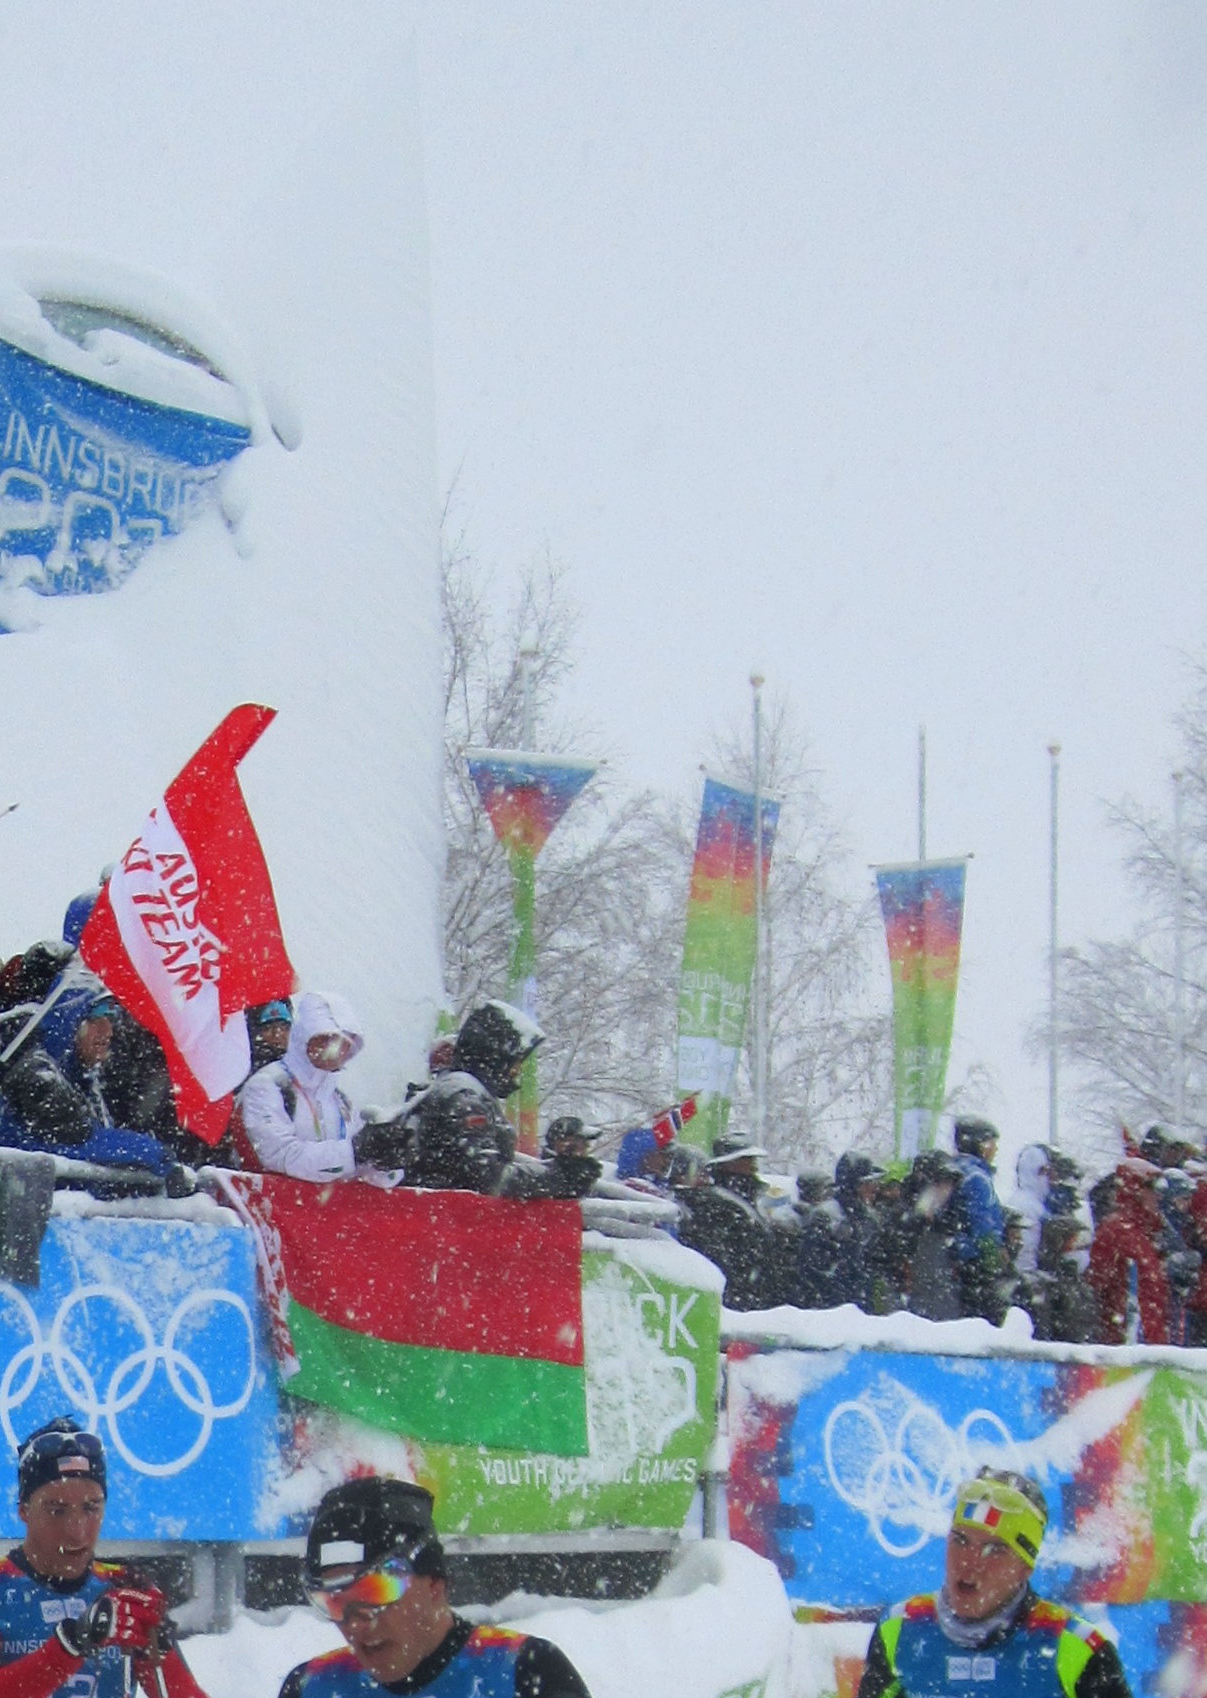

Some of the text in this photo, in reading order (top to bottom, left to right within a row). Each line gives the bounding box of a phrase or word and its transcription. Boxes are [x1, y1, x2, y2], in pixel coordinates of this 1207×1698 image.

[2, 411, 194, 530] INNSBRU
[132, 888, 203, 1001] TEAM
[479, 1458, 547, 1489] YOUTH
[638, 1457, 697, 1484] GAMES
